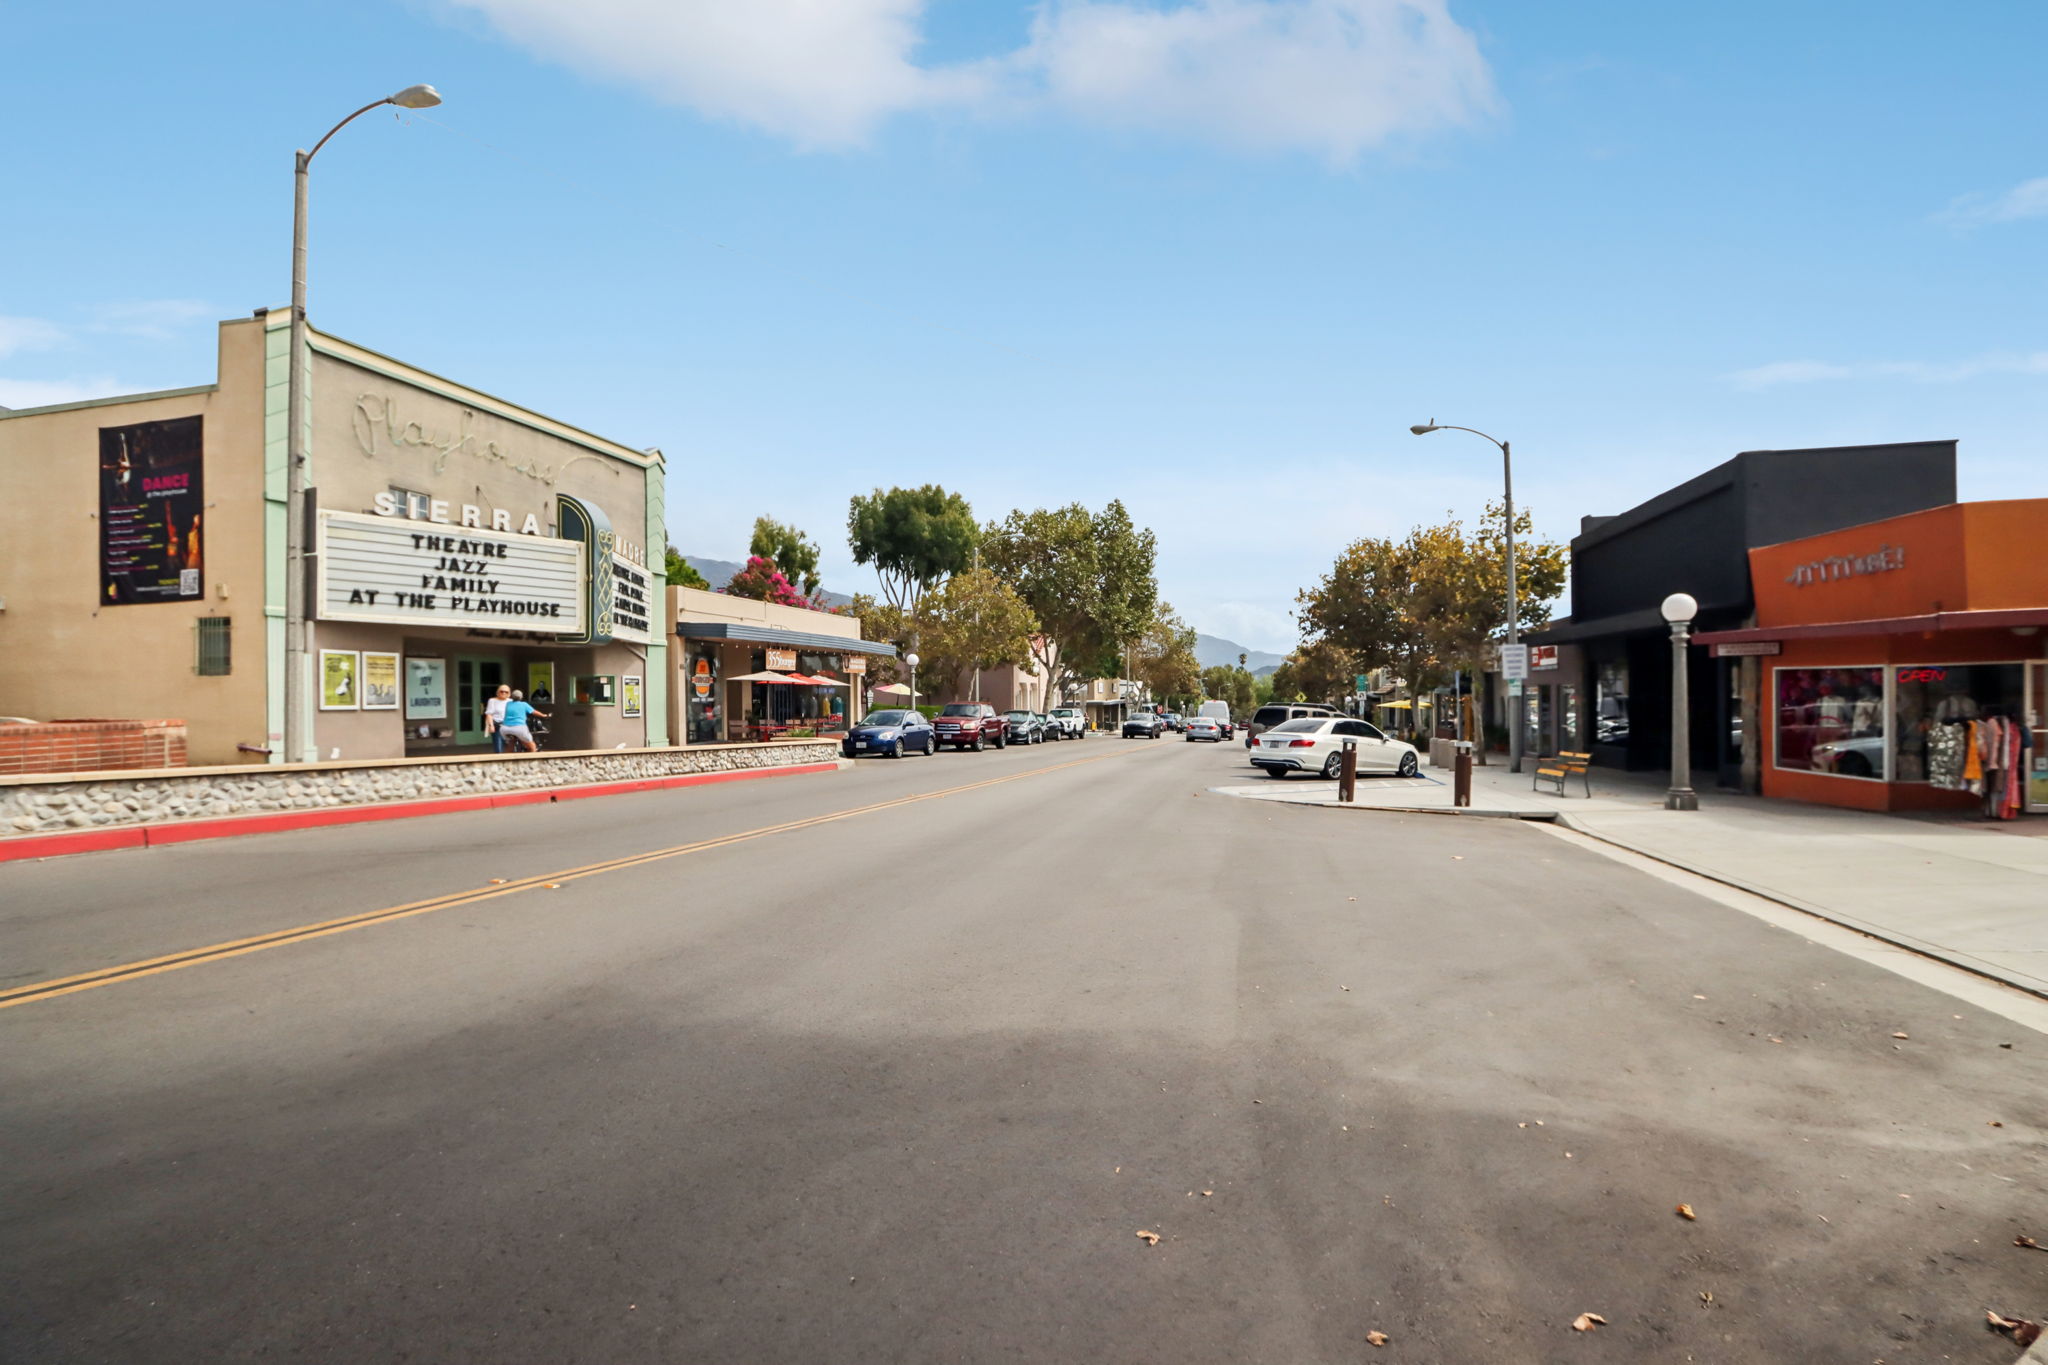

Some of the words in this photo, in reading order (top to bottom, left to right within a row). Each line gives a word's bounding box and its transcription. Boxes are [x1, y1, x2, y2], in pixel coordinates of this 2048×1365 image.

[352, 391, 619, 486] Playhouse
[142, 472, 190, 491] DANCE
[373, 492, 542, 536] SIERRA
[410, 534, 509, 559] THEATRE
[615, 535, 646, 567] MADRE
[434, 557, 489, 576] JAZZ
[421, 574, 500, 595] FAMILY
[349, 588, 380, 606] AT
[394, 591, 437, 610] THE
[450, 596, 561, 618] PLAYHOUSE
[1896, 669, 1947, 683] OPEN
